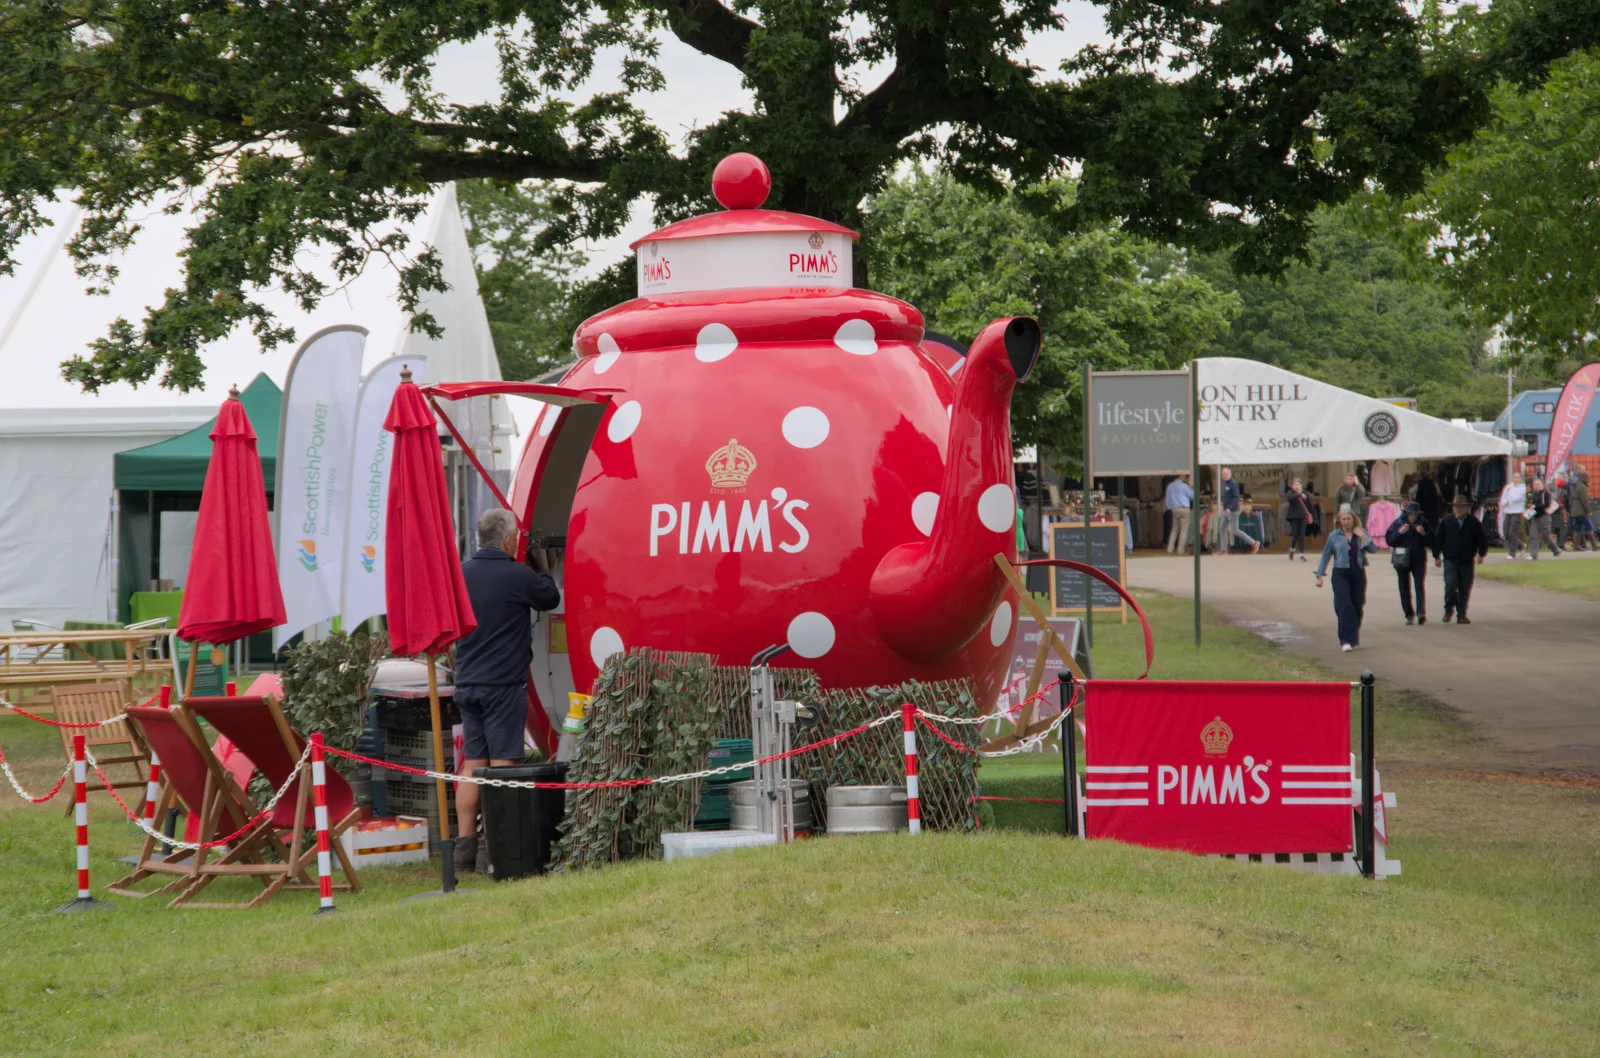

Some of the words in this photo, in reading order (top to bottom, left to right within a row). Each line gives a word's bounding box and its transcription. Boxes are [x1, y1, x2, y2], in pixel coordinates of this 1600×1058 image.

[643, 257, 671, 282] PIMM'S
[789, 250, 838, 273] PIMM'S
[1246, 384, 1308, 401] HILL
[1098, 400, 1185, 433] lifestyle
[1102, 432, 1180, 444] PAVILION
[1268, 437, 1323, 449] Schöffel
[303, 401, 328, 535] ScottishPower
[367, 424, 388, 541] ScottishPowe
[320, 466, 337, 537] Renewables
[650, 487, 810, 557] PIMM'S
